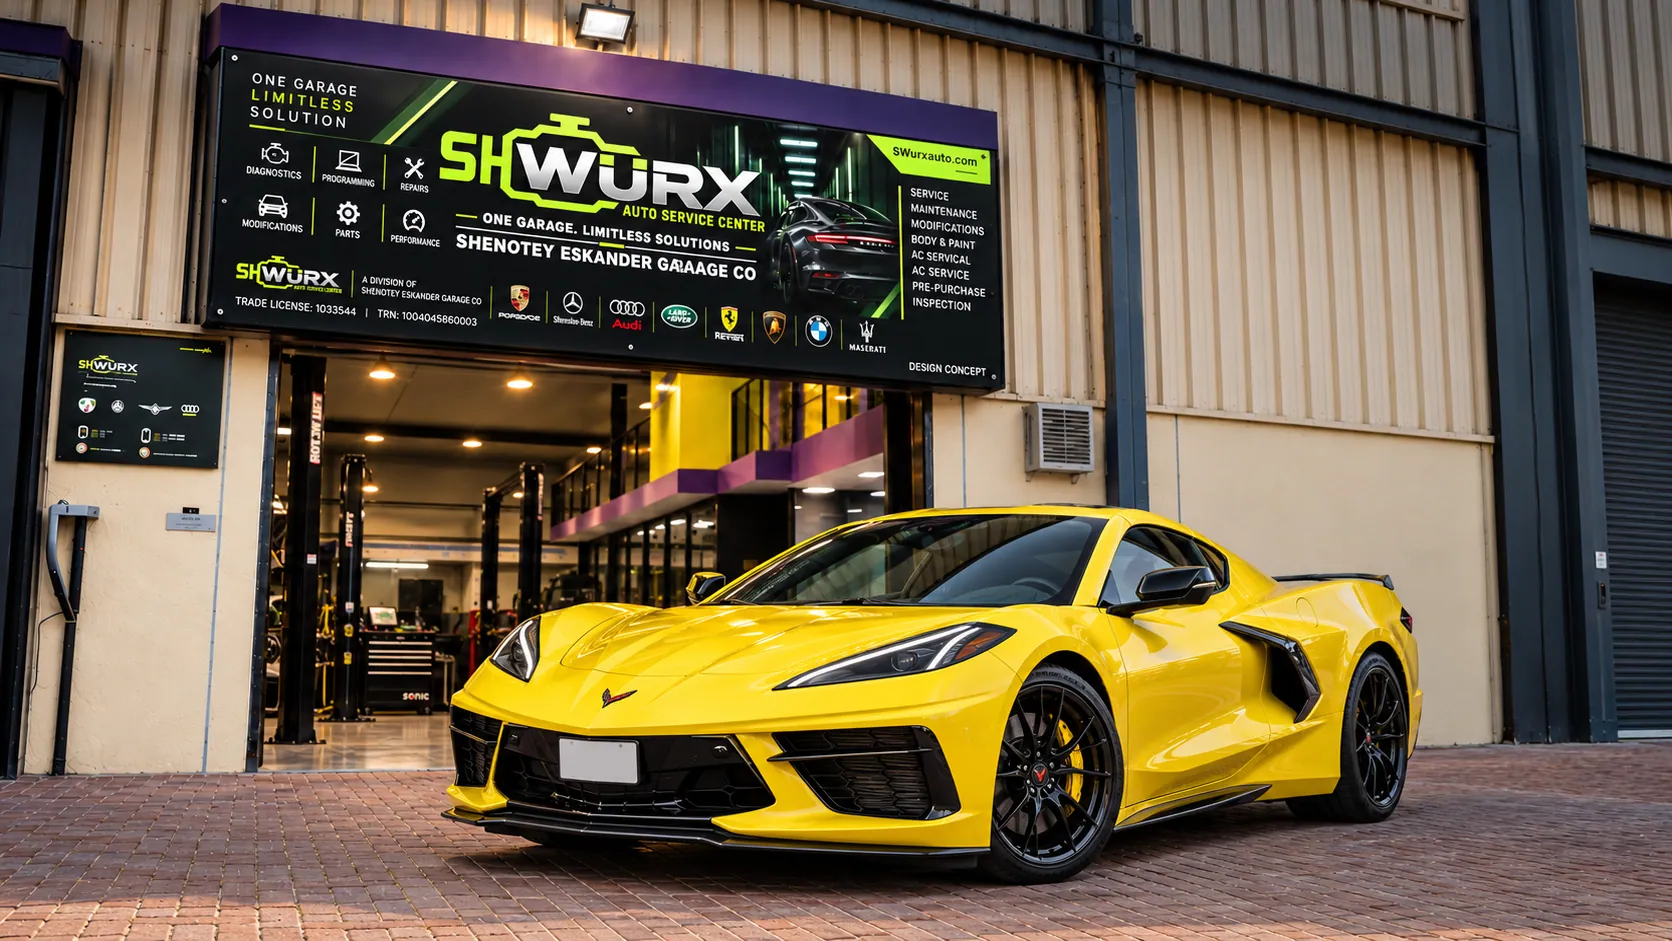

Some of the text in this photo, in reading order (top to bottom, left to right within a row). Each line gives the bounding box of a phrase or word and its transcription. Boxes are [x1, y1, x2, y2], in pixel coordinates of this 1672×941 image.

[252, 72, 357, 97] ONE GARAGE
[251, 88, 354, 113] LIMITLESS
[250, 105, 346, 129] SOLUTION
[892, 146, 978, 167] SWurxauto.com
[246, 165, 302, 180] DIAGNOSTICS
[322, 174, 375, 188] PROGRAMMING
[400, 182, 429, 194] REPAIRS
[910, 187, 949, 201] SERVICE
[622, 204, 766, 233] AUTO SERVICE CENTER
[910, 203, 978, 220] MAINTENANCE
[242, 218, 303, 233] MODIFICATIONS
[335, 228, 360, 239] PARTS
[482, 212, 730, 252] ONE GARAGE. LIMITLESS SOLUTIONS
[910, 219, 985, 236] MODIFICATIONS
[390, 234, 441, 248] PERFORMANCE
[911, 234, 976, 250] BODY & PAINT
[455, 233, 555, 259] SHENOTEY
[560, 245, 652, 270] ESKANDER
[733, 264, 757, 282] CO
[911, 250, 972, 266] AC SERVICAL
[912, 265, 970, 281] AC SERVICE
[361, 276, 417, 288] A DIVISION OF
[912, 281, 986, 298] PRE-PURCHASE
[235, 296, 357, 316] TRADE LICENSE: 1033544
[401, 291, 440, 301] ESKANDER
[441, 294, 471, 305] GARAGE
[471, 297, 482, 306] CO
[912, 297, 972, 312] INSPECTION
[377, 308, 478, 327] TRN: 1004045860003
[612, 318, 642, 331] Audi
[909, 362, 987, 377] DESIGN CONCEPT
